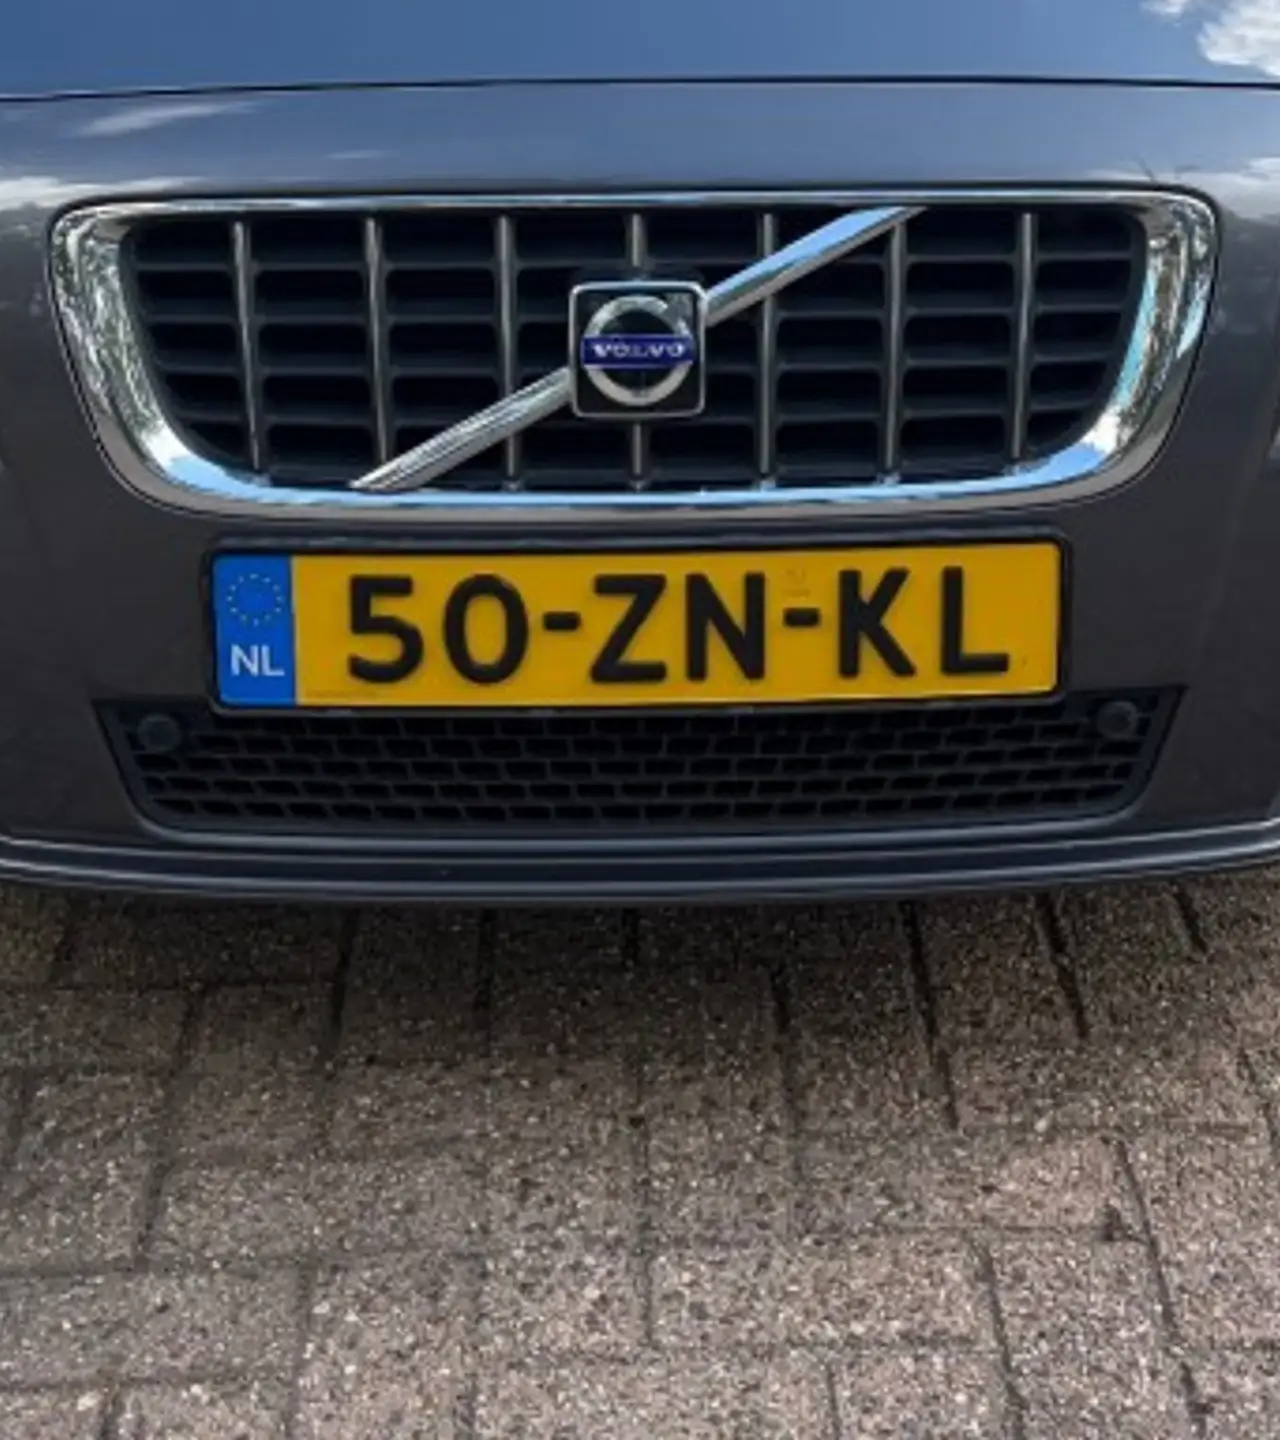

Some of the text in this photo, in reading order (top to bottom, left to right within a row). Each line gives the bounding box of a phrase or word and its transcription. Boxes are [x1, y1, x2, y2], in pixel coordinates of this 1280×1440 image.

[593, 342, 686, 359] VOLVO
[347, 566, 1011, 686] 50-ZN-KL
[230, 643, 286, 678] NL
